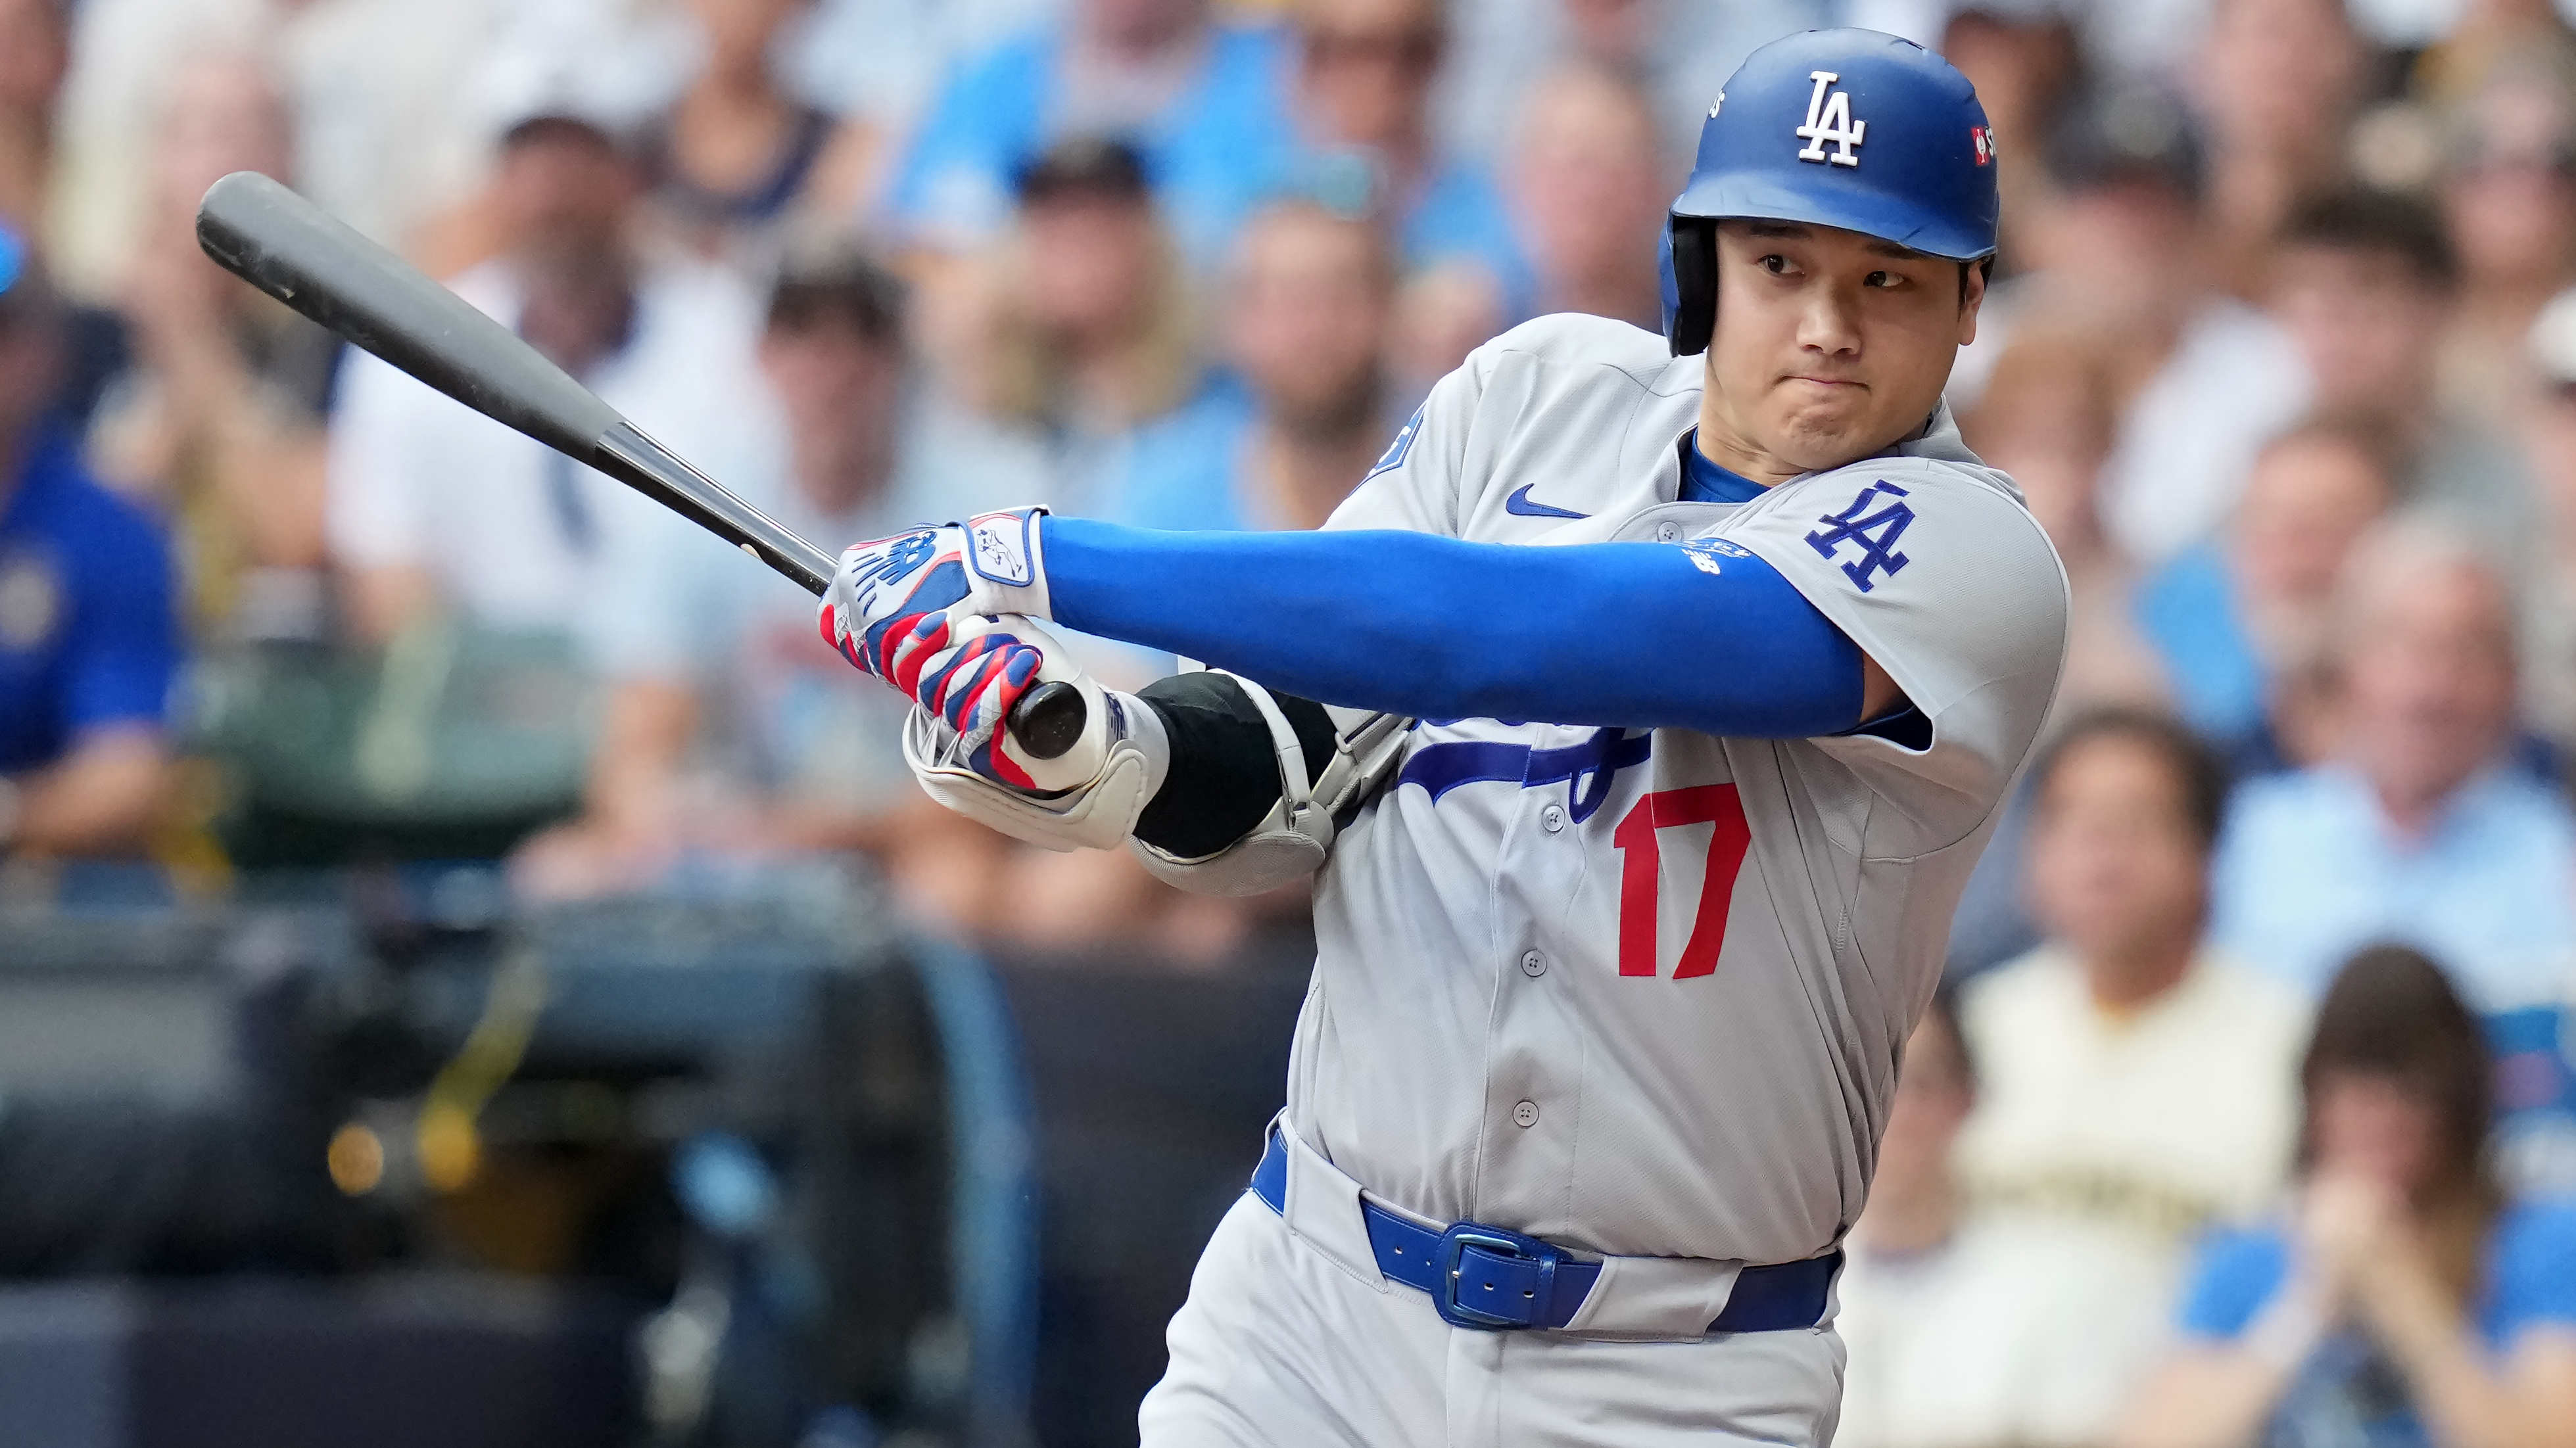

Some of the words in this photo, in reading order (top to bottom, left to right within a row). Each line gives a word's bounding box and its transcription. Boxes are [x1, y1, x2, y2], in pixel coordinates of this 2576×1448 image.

[1796, 70, 1866, 167] LA
[1803, 479, 1916, 593] LA
[1613, 782, 1752, 980] 17
